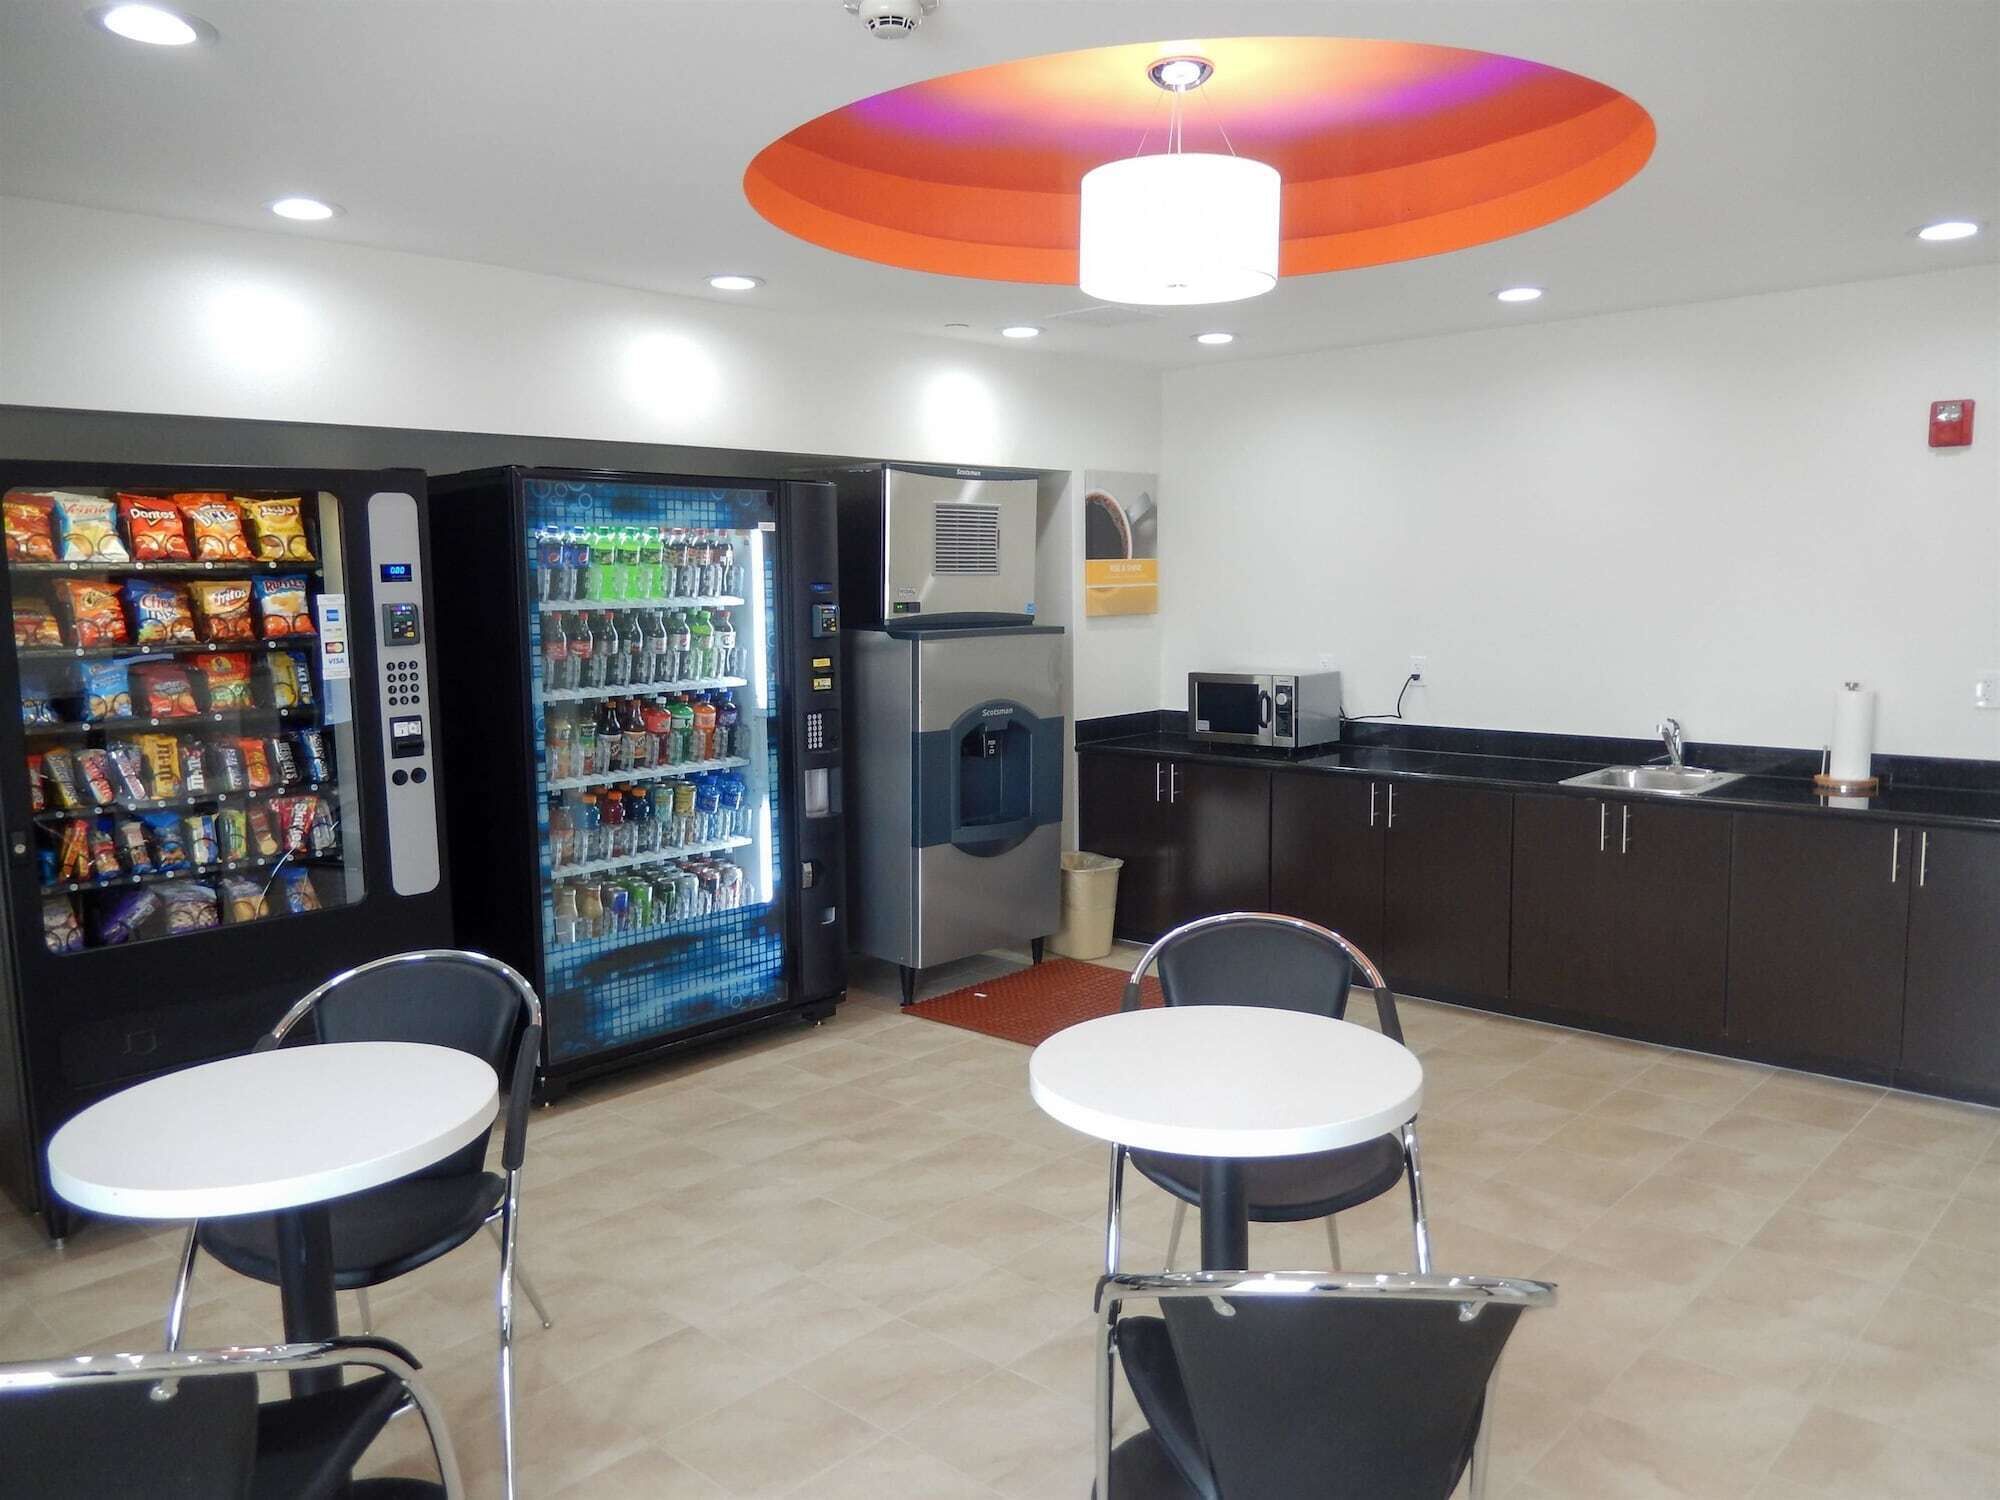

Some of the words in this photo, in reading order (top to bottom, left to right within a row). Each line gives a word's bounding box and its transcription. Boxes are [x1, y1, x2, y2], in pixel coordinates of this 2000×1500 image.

[130, 508, 176, 519] Doritos
[329, 657, 345, 665] VISA
[982, 707, 1014, 717] Scotsman
